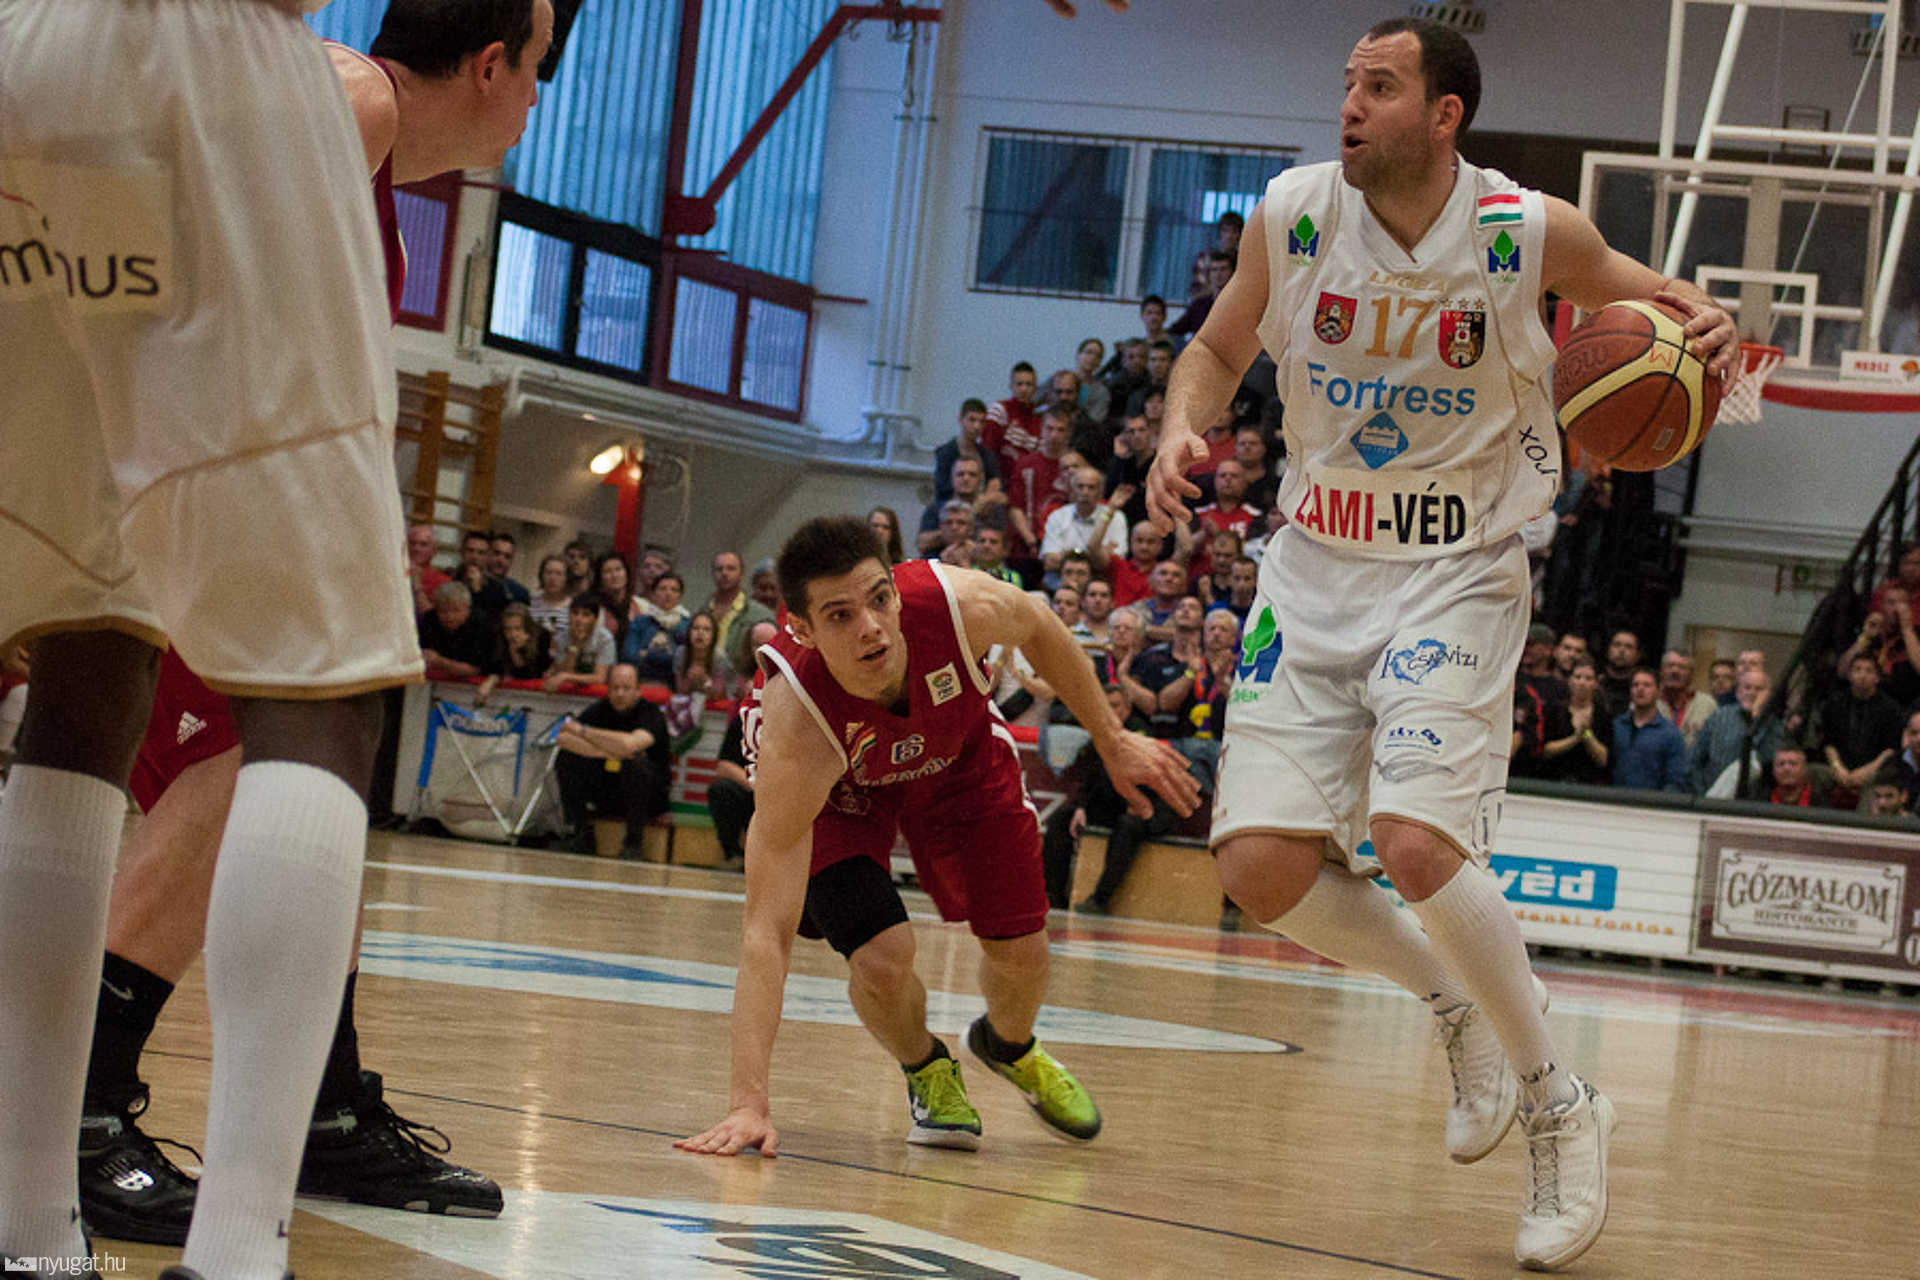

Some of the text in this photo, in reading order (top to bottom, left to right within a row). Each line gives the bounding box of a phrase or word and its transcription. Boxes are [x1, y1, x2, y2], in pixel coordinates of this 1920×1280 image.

[1364, 295, 1438, 360] 17
[1307, 361, 1476, 416] Fortress
[1727, 862, 1891, 924] GŐZMALOM
